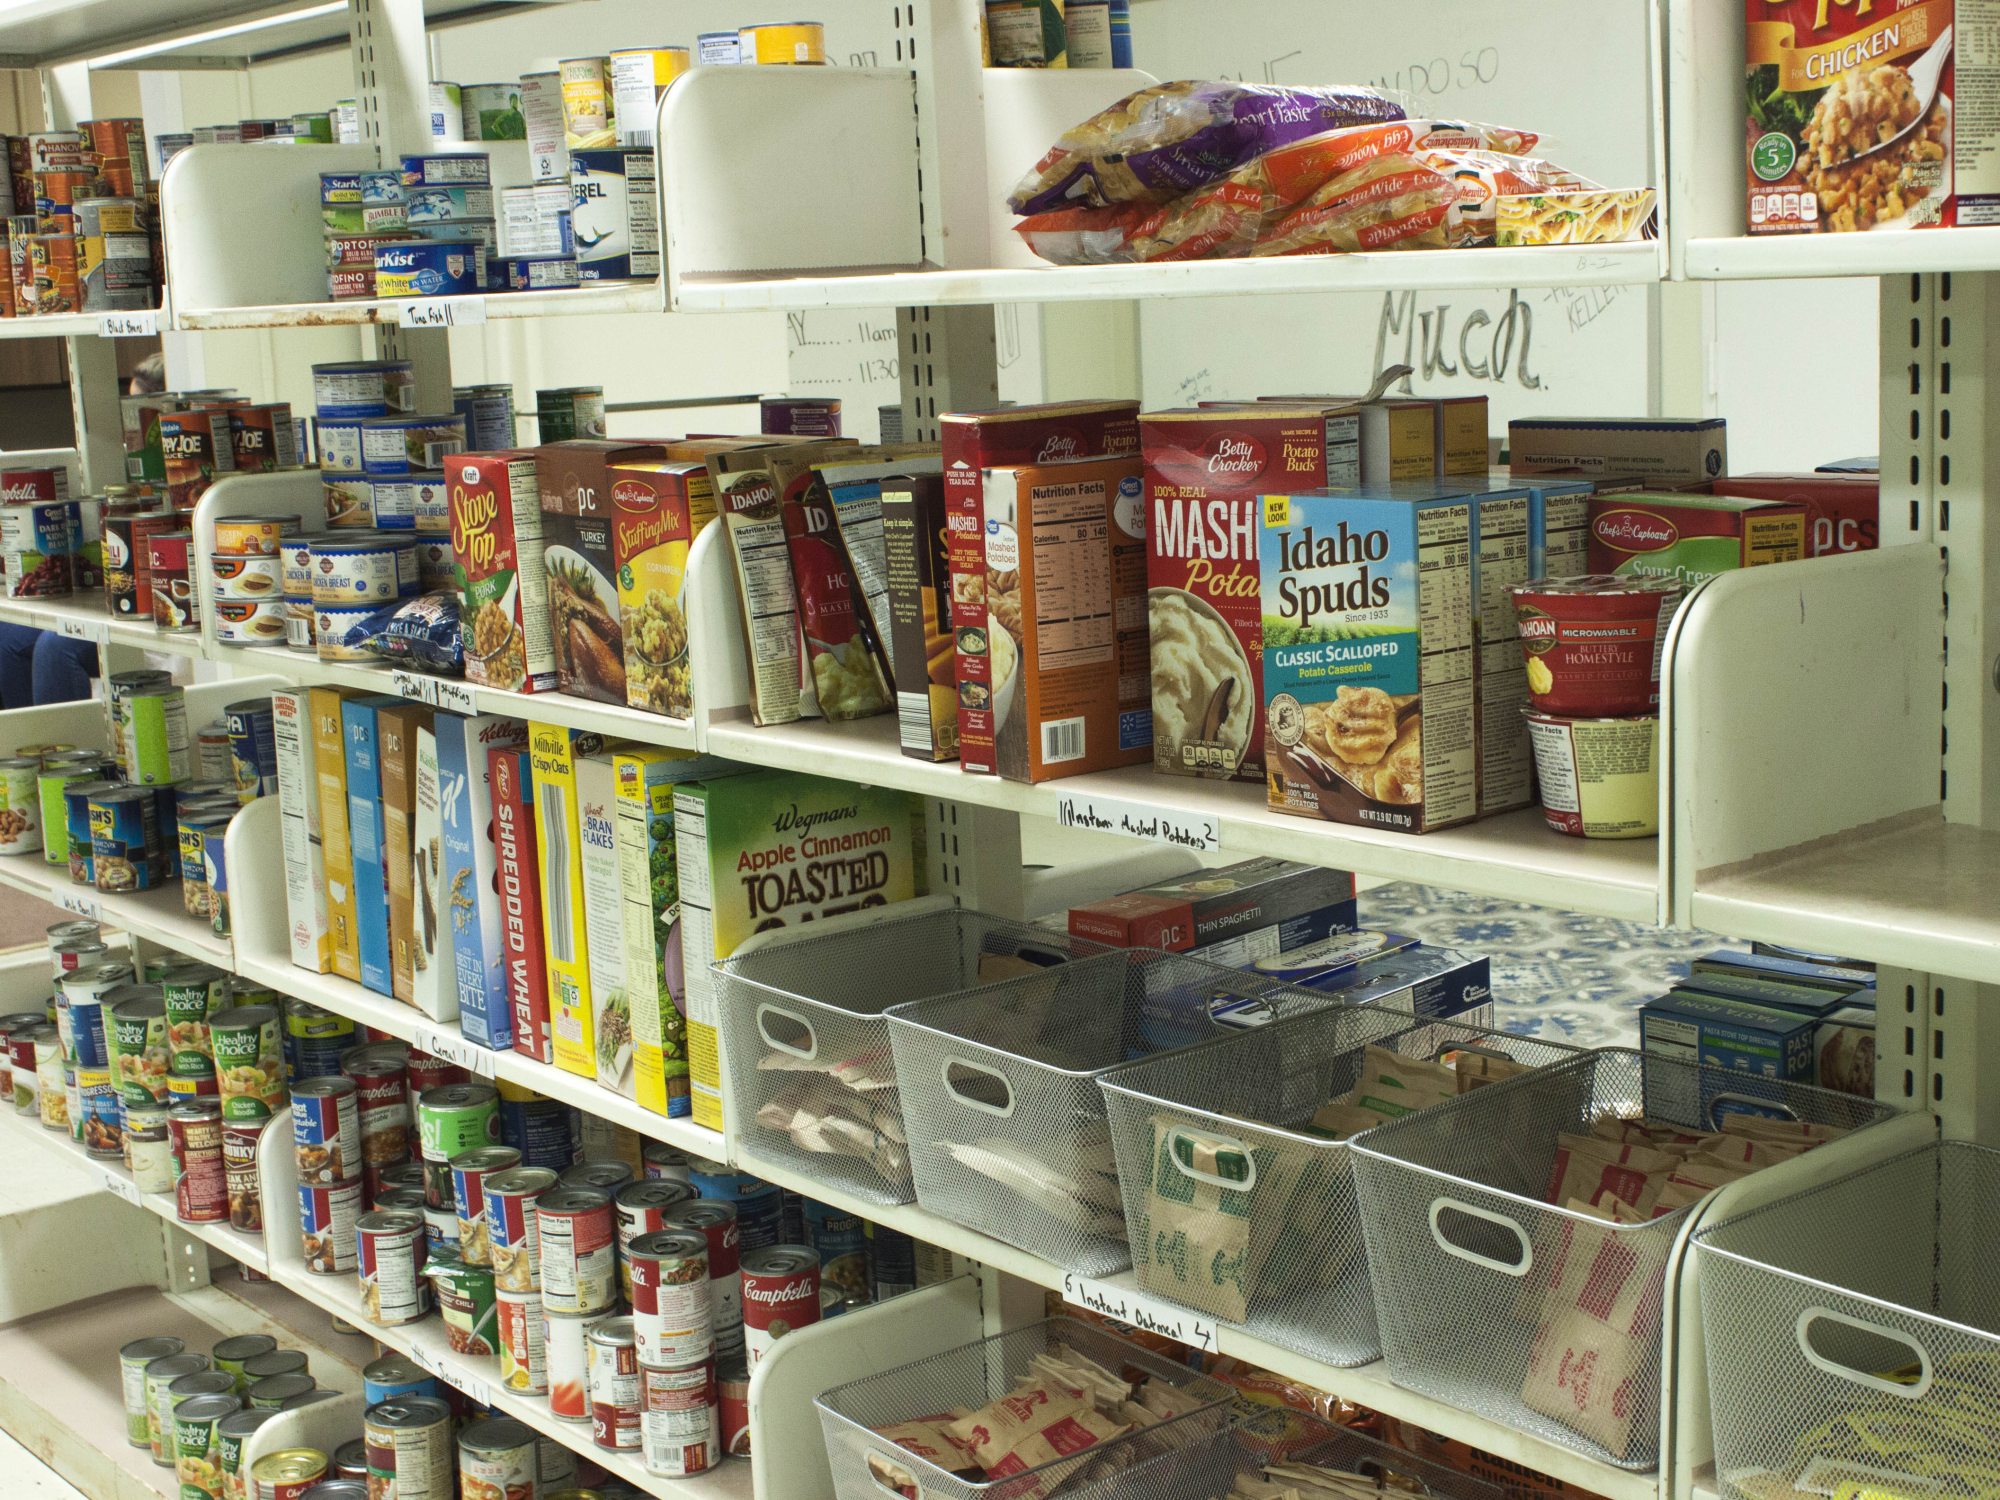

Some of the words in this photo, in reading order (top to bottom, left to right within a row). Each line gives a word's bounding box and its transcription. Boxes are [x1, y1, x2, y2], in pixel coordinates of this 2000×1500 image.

[1806, 24, 1900, 81] CHICKEN
[1276, 105, 1312, 124] Taste
[1383, 131, 1410, 150] Egg
[626, 155, 654, 163] Nutrition
[1766, 149, 1779, 167] 5
[332, 180, 361, 190] StarKi
[1374, 179, 1403, 198] Wide
[368, 208, 398, 221] BUMBLE
[1367, 225, 1397, 243] Wide
[374, 251, 416, 268] arKist
[382, 279, 408, 289] White
[420, 275, 444, 287] WATER
[857, 321, 896, 343] 11am
[178, 436, 203, 452] JOE
[239, 430, 263, 448] JOE
[1045, 436, 1077, 457] Betty
[1102, 434, 1138, 449] Potato
[1219, 438, 1254, 460] Betty
[1282, 443, 1319, 459] Potato
[1208, 453, 1260, 473] Crocker
[1286, 457, 1317, 472] Buds
[1525, 455, 1571, 465] Nutrition
[1573, 456, 1604, 466] Facts
[463, 469, 478, 483] Kraft
[732, 486, 776, 511] IDAHOA
[1032, 486, 1077, 500] Nutrition
[1078, 483, 1106, 496] Facts
[1153, 485, 1177, 498] 100%
[1179, 485, 1207, 499] REAL
[837, 501, 878, 512] Nutrition
[1269, 502, 1285, 514] NEW
[1480, 501, 1509, 514] Nutrition
[1509, 498, 1527, 511] Facts
[1546, 496, 1577, 508] Nutrition
[1267, 510, 1288, 525] LOOK!
[1418, 509, 1449, 522] Nutrition
[1450, 506, 1468, 518] Facts
[737, 525, 765, 537] Nutrition
[948, 516, 977, 532] MASHED
[1154, 498, 1260, 561] MASH
[1751, 524, 1779, 533] Nutrition
[1780, 522, 1798, 531] Facts
[580, 530, 607, 544] TURKEY
[619, 517, 662, 556] Stuffing
[660, 511, 681, 533] Mix
[1032, 533, 1061, 545] Calories
[1077, 528, 1087, 539] 80
[1632, 524, 1671, 542] Cupboard
[988, 543, 1016, 554] Mashed
[1276, 520, 1390, 574] Idaho
[987, 552, 1017, 564] Potatoes
[1419, 560, 1440, 570] Calories
[328, 577, 351, 588] BREAST
[1183, 558, 1261, 600] Pota
[475, 580, 497, 600] PORK
[1279, 565, 1391, 630] Spuds
[1344, 611, 1368, 624] Since
[1368, 608, 1390, 621] 1933
[1561, 628, 1638, 638] MICROWAVABLE
[1275, 647, 1324, 668] CLASSIC
[1326, 641, 1399, 663] SCALLOPED
[1565, 652, 1635, 666] HOMESTYLE
[1299, 666, 1326, 679] Potato
[1327, 661, 1373, 676] Casserole
[478, 722, 529, 744] Kellogg
[534, 737, 565, 756] Millville
[532, 754, 551, 775] Crispy
[551, 758, 570, 775] Oats
[442, 772, 465, 829] K
[1303, 791, 1319, 801] REAL
[772, 803, 859, 840] Wegmans
[1358, 808, 1369, 819] NET
[587, 816, 613, 836] BRAN
[445, 833, 470, 854] Original
[583, 828, 614, 850] FLAKES
[736, 843, 797, 873] Apple
[800, 825, 892, 859] Cinnamon
[741, 850, 890, 919] TOASTED
[498, 803, 526, 953] SHREDDED
[512, 959, 535, 1053] WHEAT
[1198, 917, 1218, 935] THIN
[1218, 907, 1262, 931] SPAGHETTI
[455, 951, 471, 971] BEST
[457, 968, 484, 991] EVERY
[167, 998, 206, 1011] Choice
[168, 988, 208, 1006] Healthy
[459, 984, 488, 1011] BITE
[1645, 1015, 1675, 1028] Nutrition
[1676, 1022, 1698, 1032] Facts
[215, 1042, 258, 1056] Choice
[218, 1033, 259, 1049] Healthy
[1786, 1030, 1814, 1055] PAST
[178, 1056, 202, 1065] Chicken
[357, 1081, 401, 1101] ampbell's
[231, 1101, 257, 1110] Chicken
[232, 1108, 257, 1116] Noodle
[744, 1277, 814, 1307] Campbell's
[1064, 1273, 1073, 1292] 6
[1079, 1283, 1127, 1319] Instant
[1135, 1307, 1184, 1339] Oatmeal
[1194, 1321, 1211, 1350] 4
